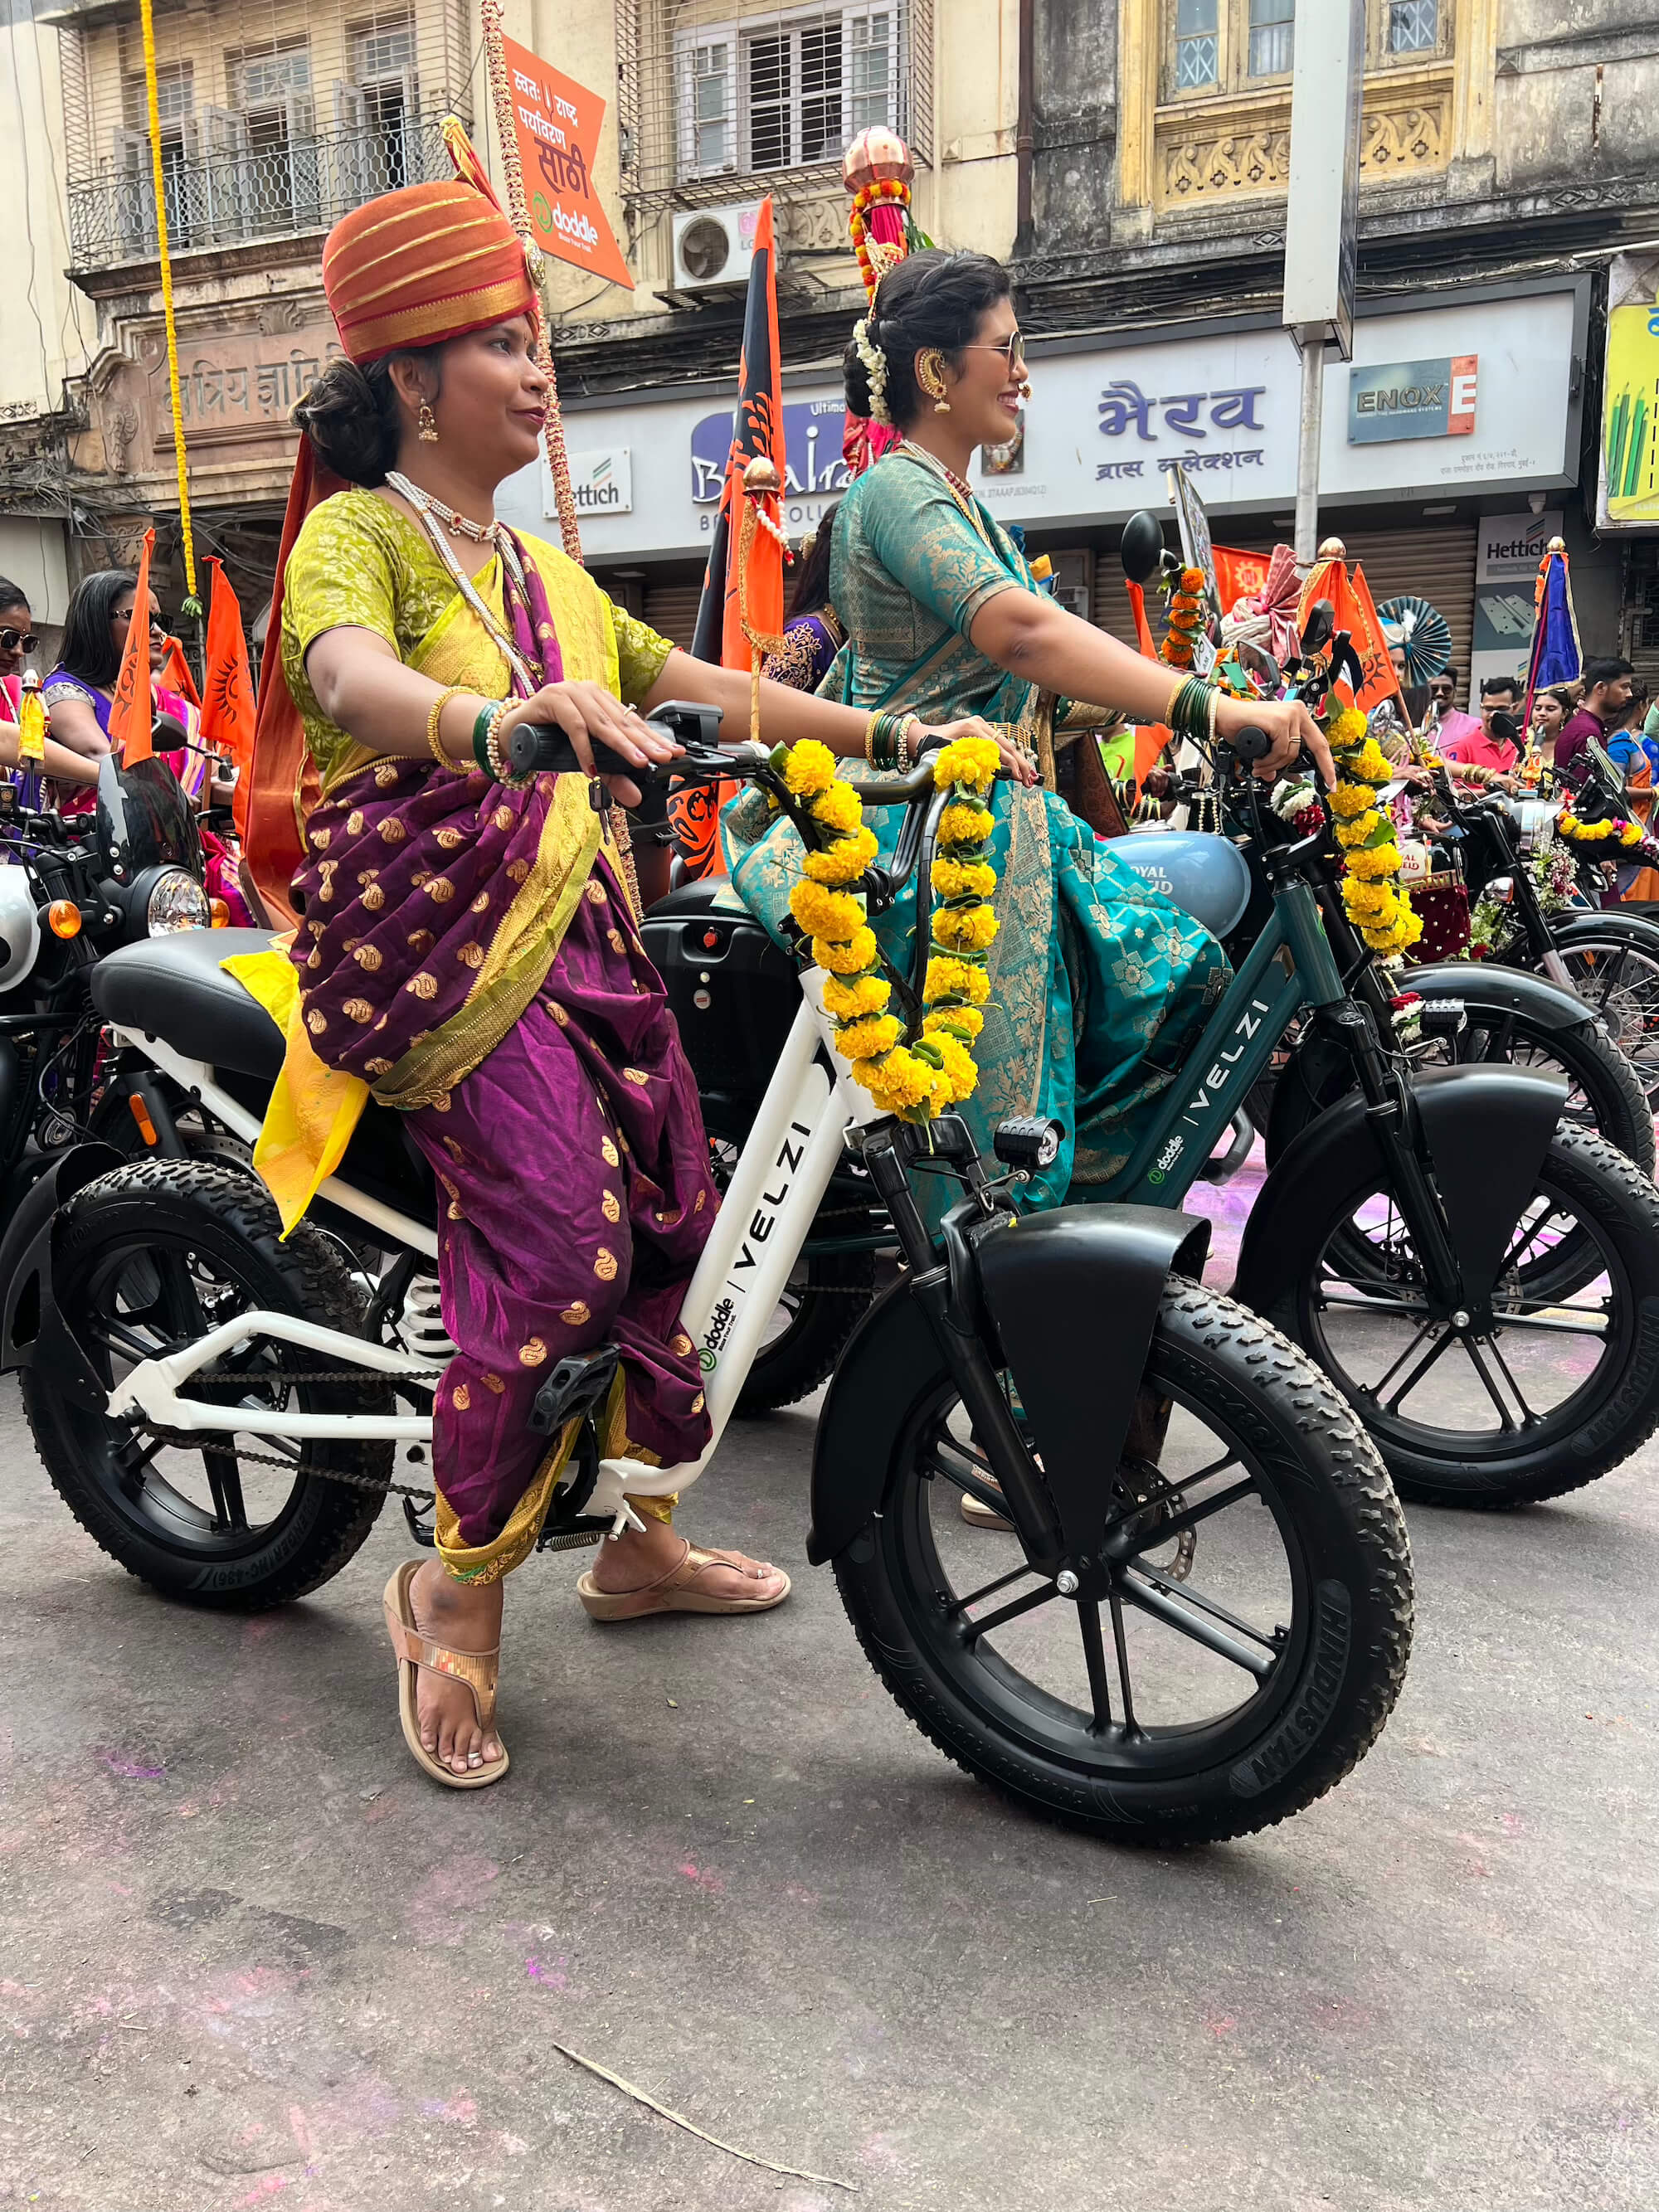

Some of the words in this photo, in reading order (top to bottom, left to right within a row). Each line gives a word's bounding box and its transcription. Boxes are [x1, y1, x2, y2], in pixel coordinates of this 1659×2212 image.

[512, 68, 541, 101] स्वतः
[554, 95, 578, 127] राष्ट्र
[518, 105, 567, 150] पर्यावरण
[534, 136, 589, 199] साठी
[552, 202, 598, 246] doddle
[1098, 380, 1267, 441] भैरव
[1357, 384, 1444, 413] ENOX
[1095, 460, 1144, 481] ब्रास
[1156, 1135, 1184, 1170] doddle
[1189, 999, 1270, 1109] VELZI
[703, 1298, 734, 1350] doddle
[733, 1121, 811, 1269] VELZI
[1250, 1600, 1350, 1787] HINDUSTAN
